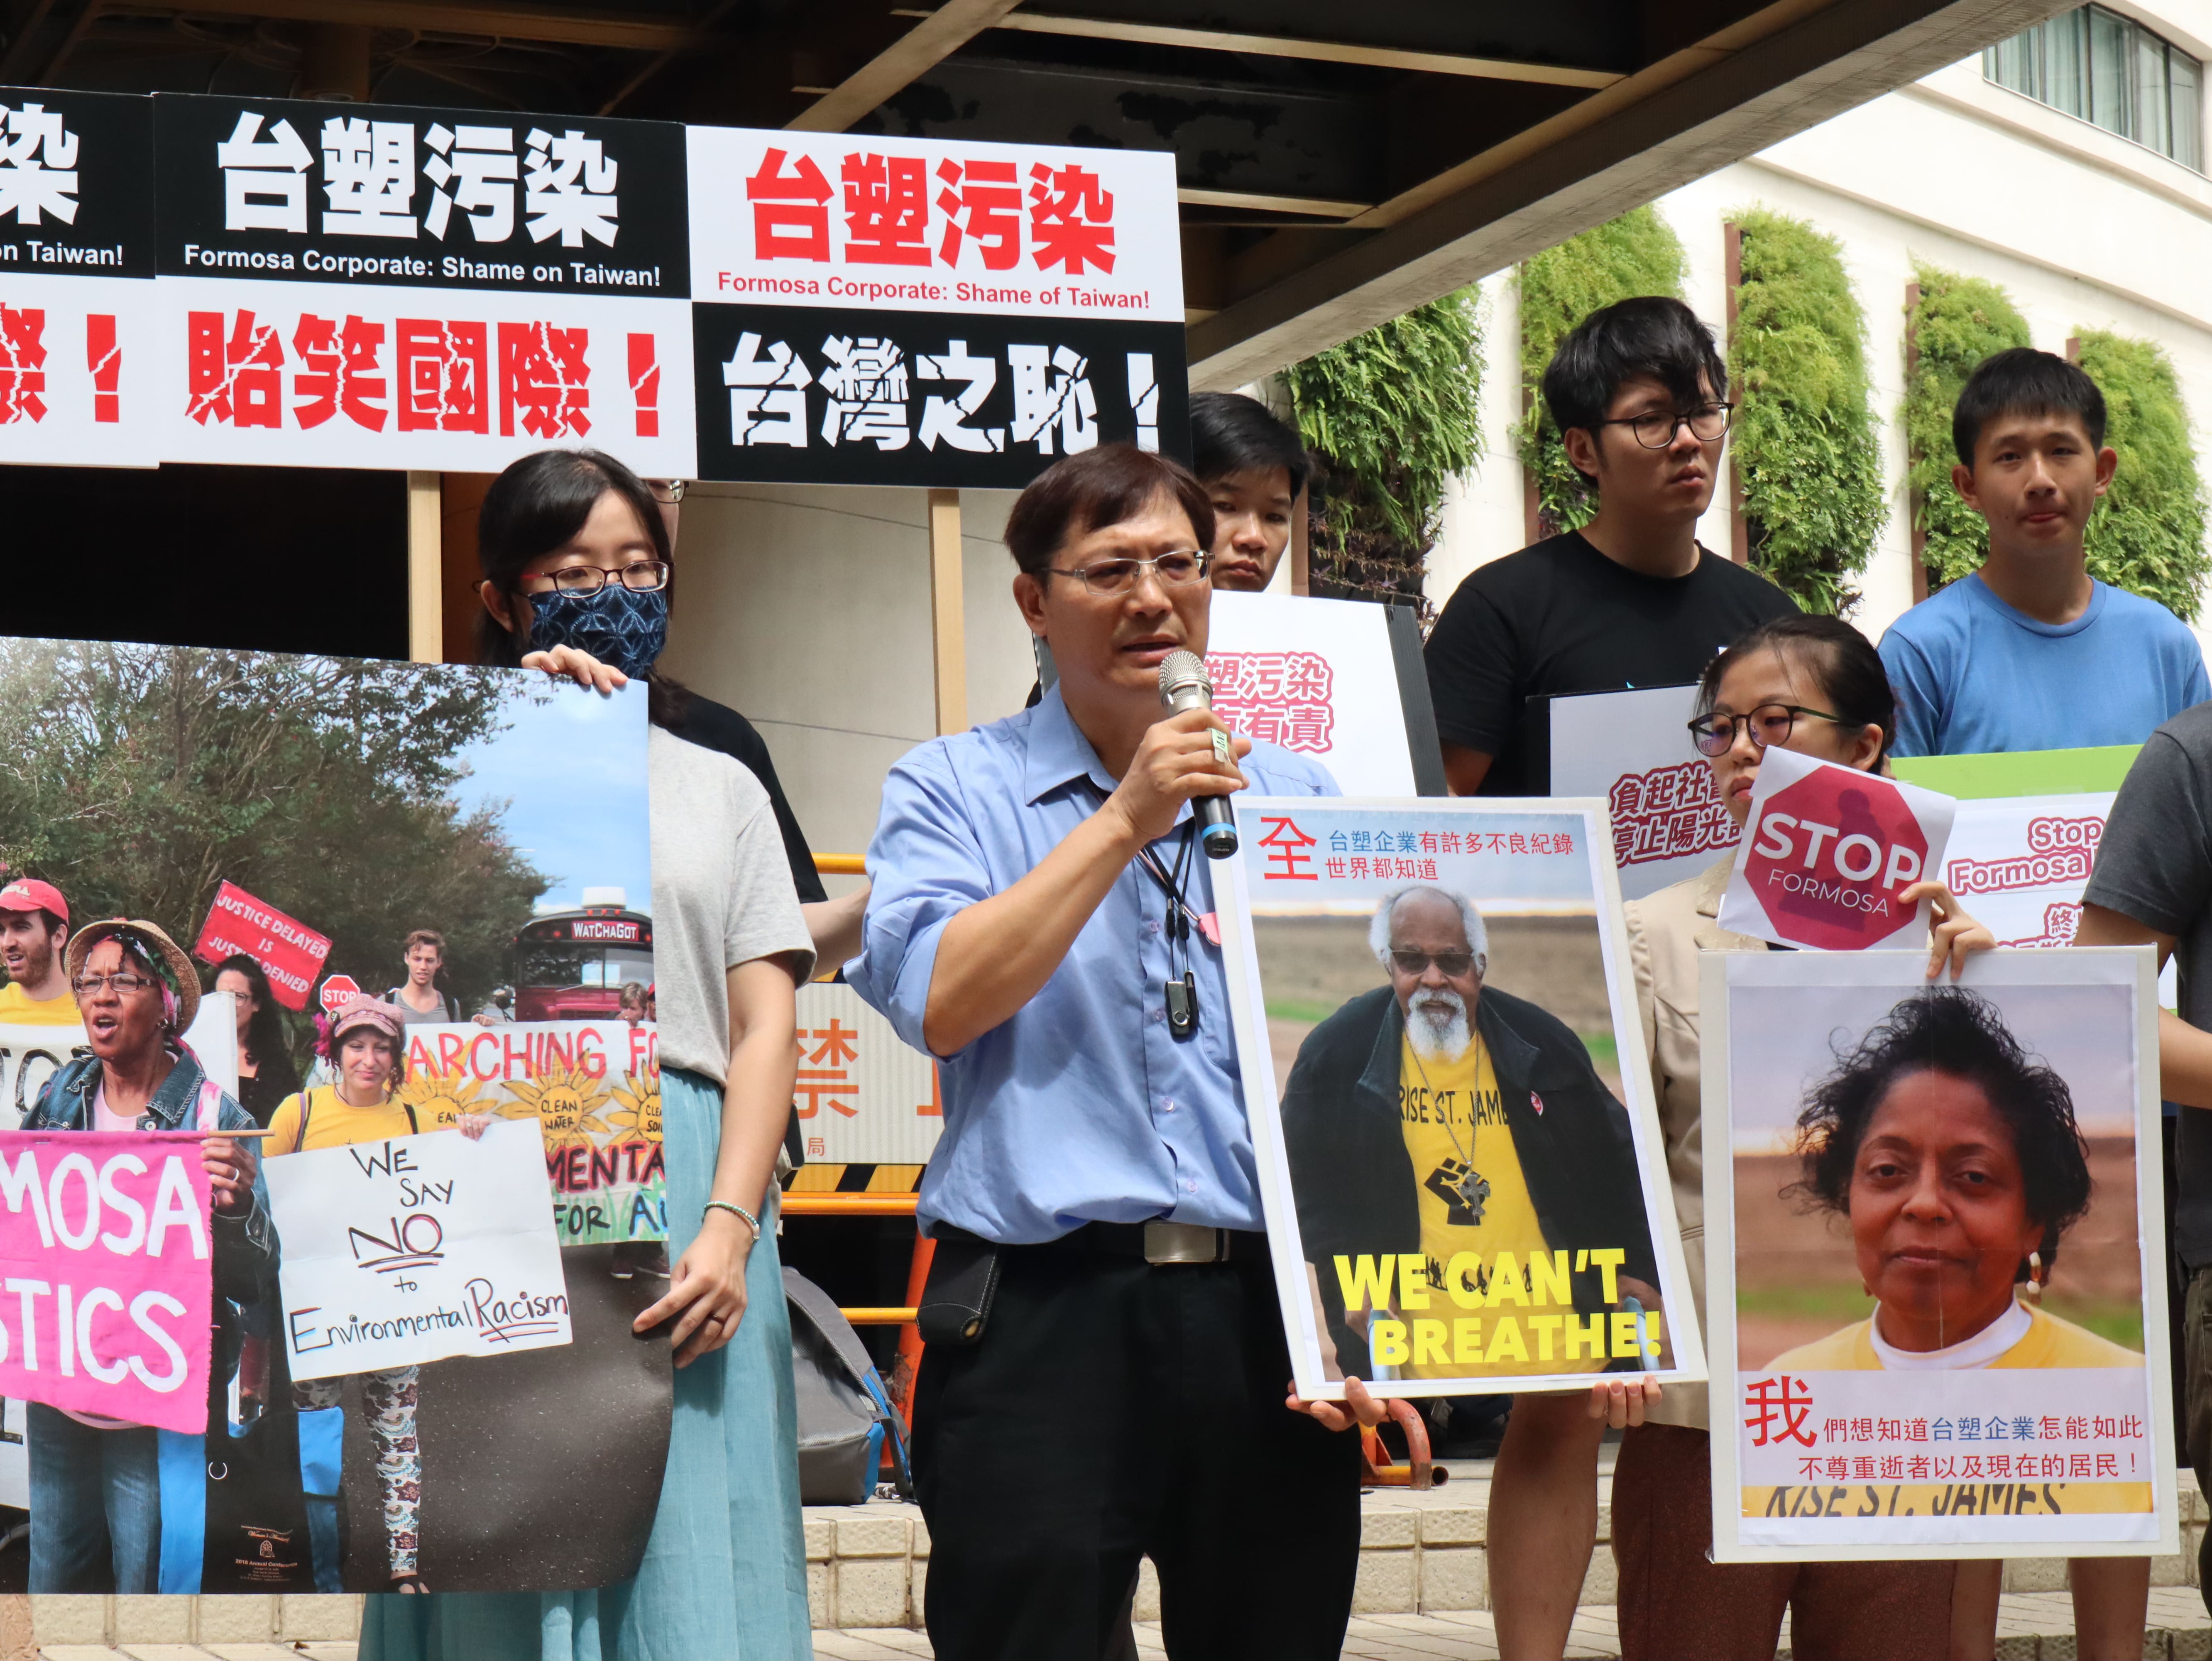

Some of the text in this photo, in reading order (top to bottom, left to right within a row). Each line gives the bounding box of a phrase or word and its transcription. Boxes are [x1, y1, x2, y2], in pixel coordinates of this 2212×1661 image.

[217, 110, 619, 248] 台塑污染
[746, 147, 1117, 275] 台塑污染
[0, 240, 122, 266] n Taiwan!
[185, 244, 660, 287] Formosa Corporate: Shame on Taiwan!
[719, 272, 1150, 309] Formosa Corporate: Shame of Taiwan!
[1258, 817, 1319, 881] 全
[1329, 830, 1573, 855] 台塑企業有許多不良紀錄
[1754, 812, 1921, 889] STOP
[2034, 823, 2101, 847] Stop
[1326, 857, 1439, 880] 世界都知道
[1954, 856, 2083, 890] Formosa
[1768, 868, 1889, 917] FORMOSA
[217, 895, 328, 959] JUSTICE DELAYED
[258, 938, 275, 953] IS
[261, 960, 310, 993] DENIED
[323, 990, 358, 1003] STOP
[406, 1027, 606, 1083] ARCHING
[541, 1099, 577, 1114] CLEAN
[545, 1115, 575, 1130] WATER
[350, 1141, 418, 1178] WE
[0, 1150, 209, 1260] MOSA
[400, 1178, 453, 1207] SAY
[348, 1213, 443, 1260] NO
[553, 1204, 611, 1235] FOR
[394, 1276, 417, 1291] to
[1334, 1248, 1625, 1311] WE CAN'T
[290, 1277, 569, 1354] Environmental Racism
[1373, 1311, 1661, 1366] BREATHE!
[1745, 1375, 1818, 1448] 我
[1823, 1414, 2143, 1443] 們想知道台塑企業怎能如此
